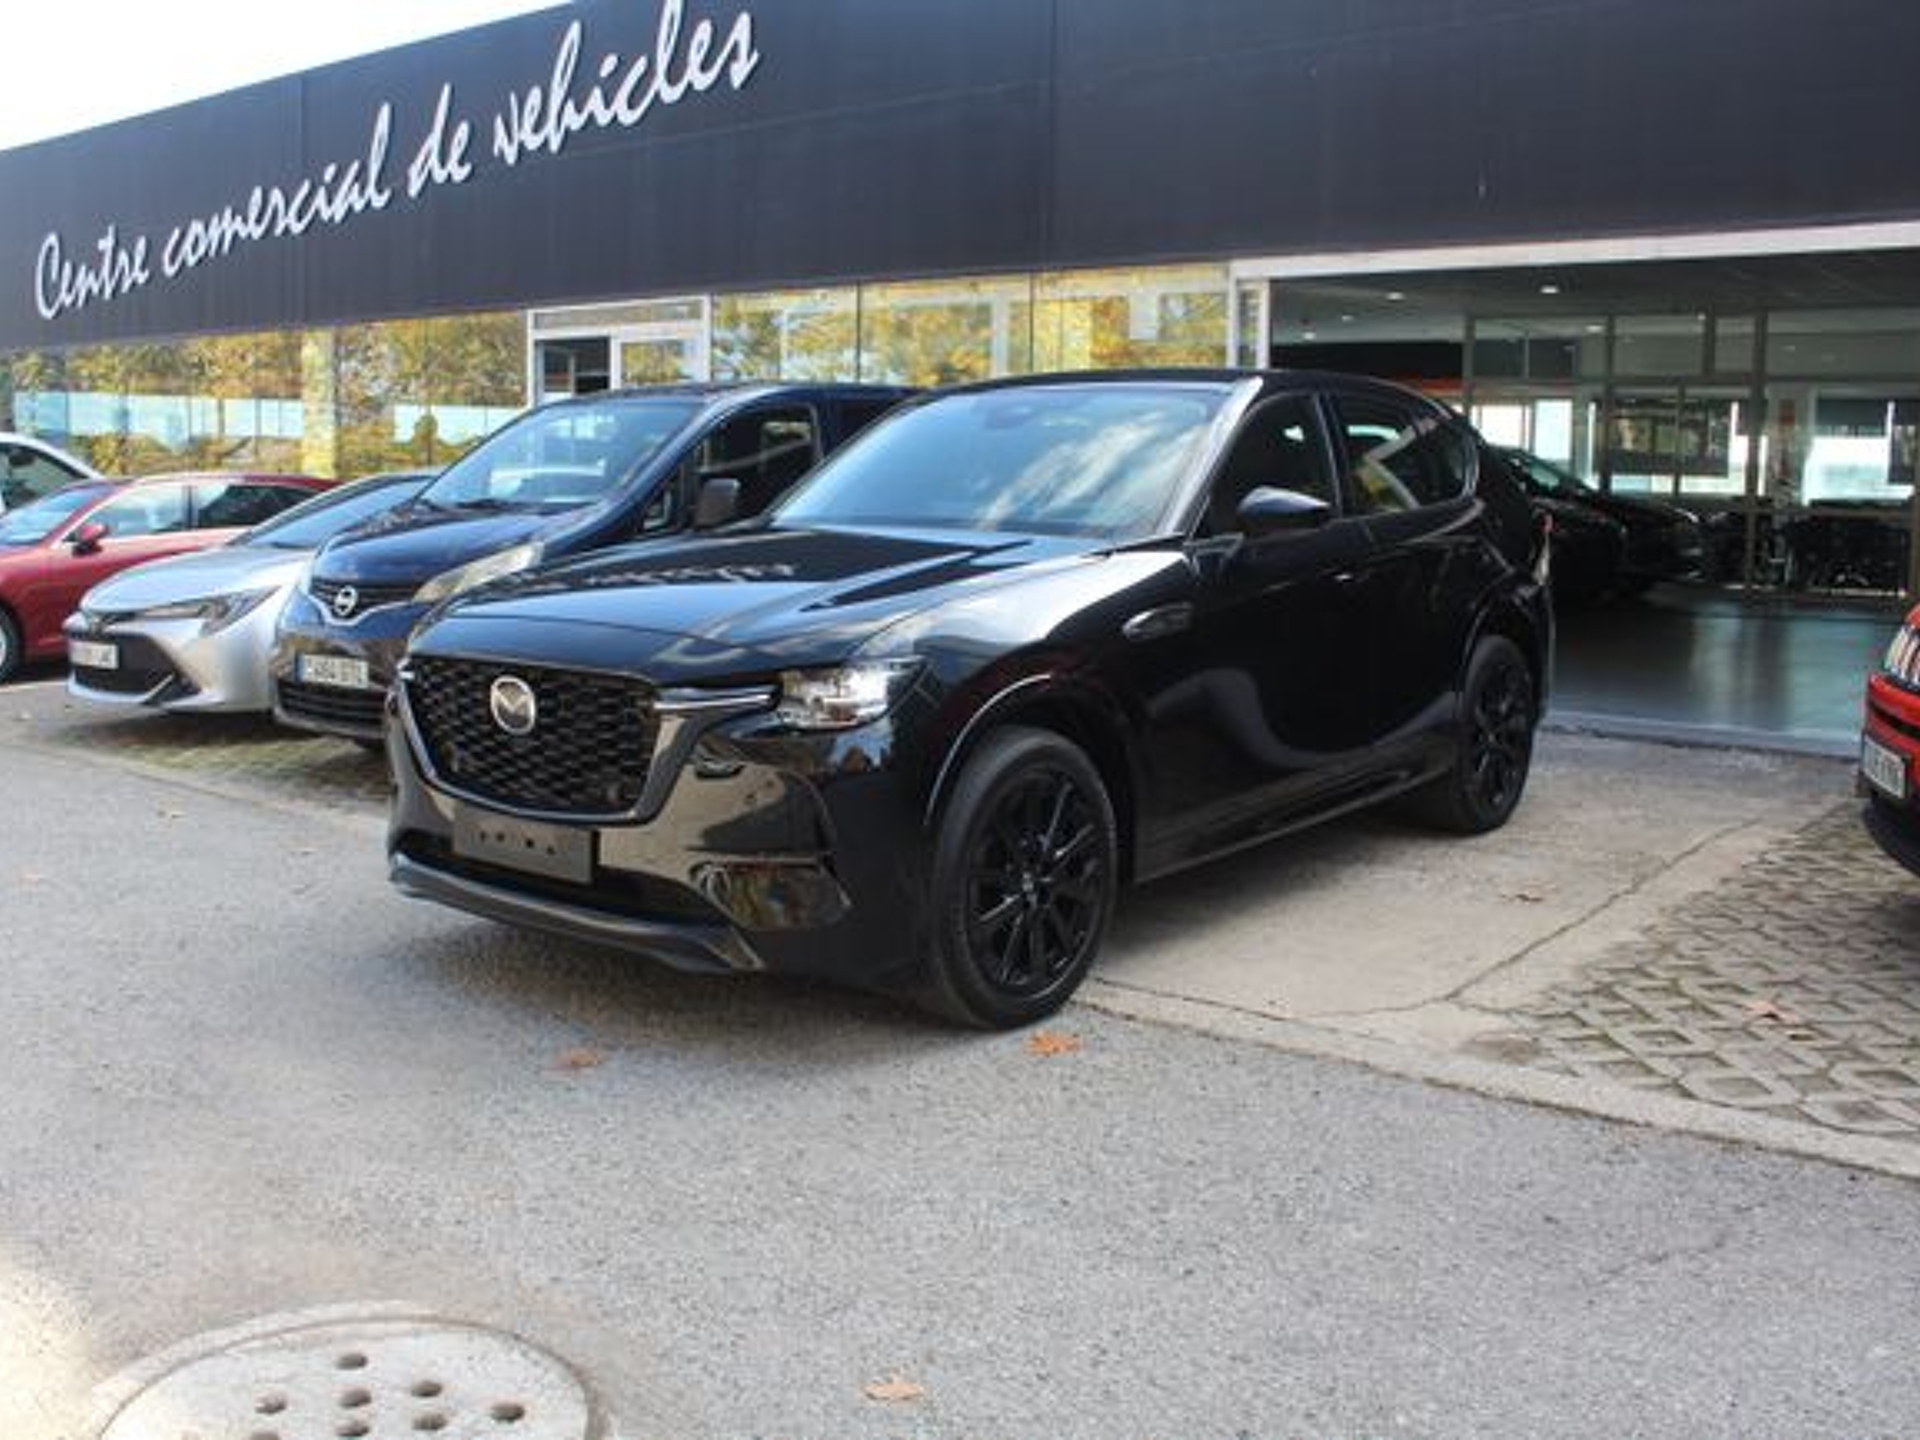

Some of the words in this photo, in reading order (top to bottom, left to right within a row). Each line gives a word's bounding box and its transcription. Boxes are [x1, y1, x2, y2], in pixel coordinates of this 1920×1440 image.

[34, 224, 150, 320] Centre
[161, 102, 391, 278] comercial
[407, 82, 472, 198] de
[493, 0, 759, 165] vehicles
